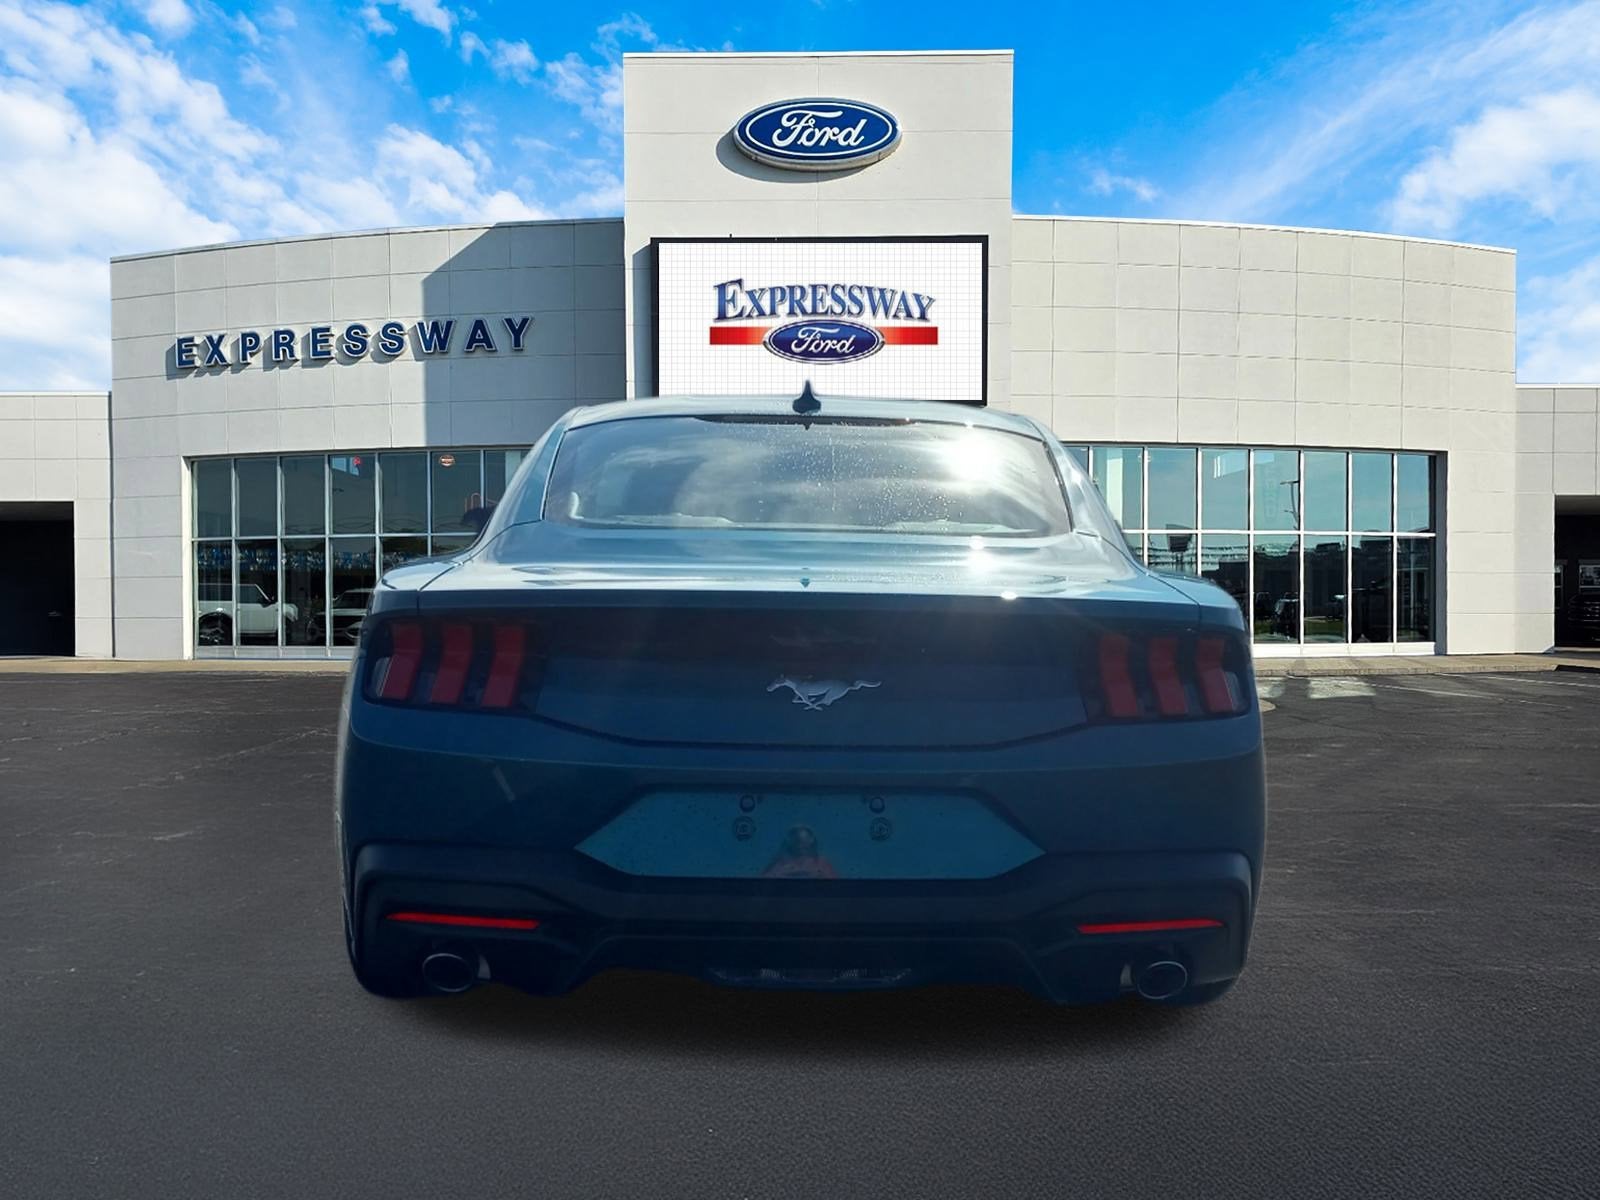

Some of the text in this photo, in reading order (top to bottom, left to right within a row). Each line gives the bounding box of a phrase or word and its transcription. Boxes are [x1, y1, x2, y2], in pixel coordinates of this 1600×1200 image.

[771, 109, 867, 147] Ford
[713, 278, 936, 322] EXPRESSWAY
[175, 316, 533, 369] EXPRESSWAY
[790, 326, 855, 354] Ford
